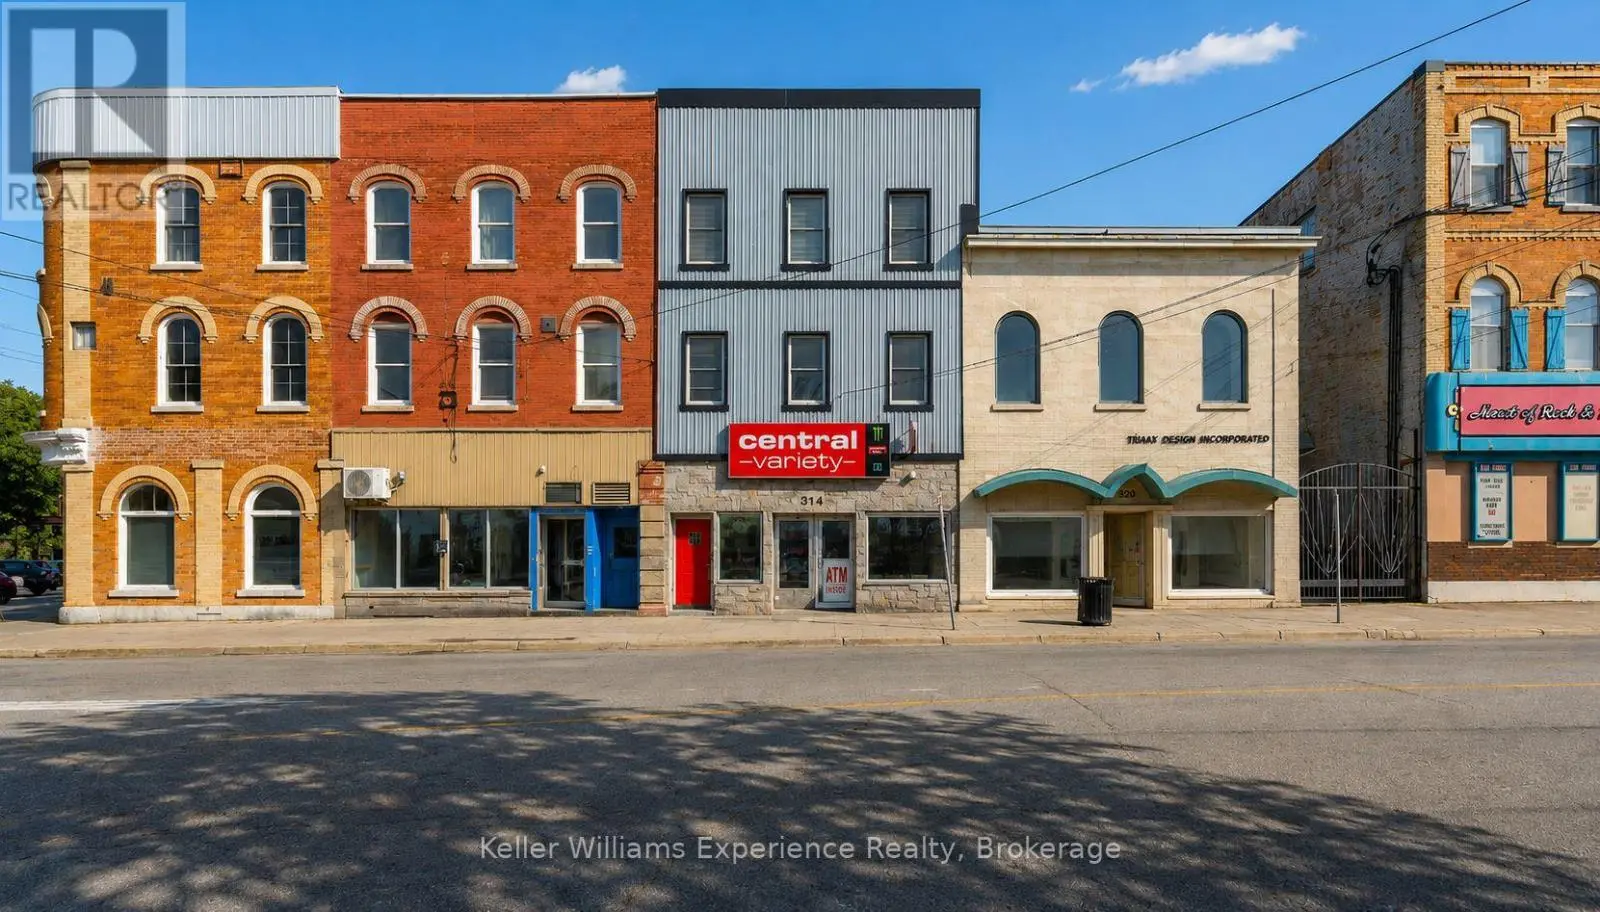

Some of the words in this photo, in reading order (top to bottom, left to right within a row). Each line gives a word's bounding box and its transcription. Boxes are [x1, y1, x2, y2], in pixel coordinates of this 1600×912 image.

[1520, 404, 1538, 425] of
[1539, 403, 1576, 420] Rock
[1578, 404, 1595, 420] &
[738, 430, 858, 450] central
[1127, 435, 1158, 445] TRIAAX
[1161, 435, 1196, 444] DESIGN
[1198, 434, 1270, 444] INCORPORATED
[800, 496, 824, 507] 314
[826, 566, 848, 583] ATM
